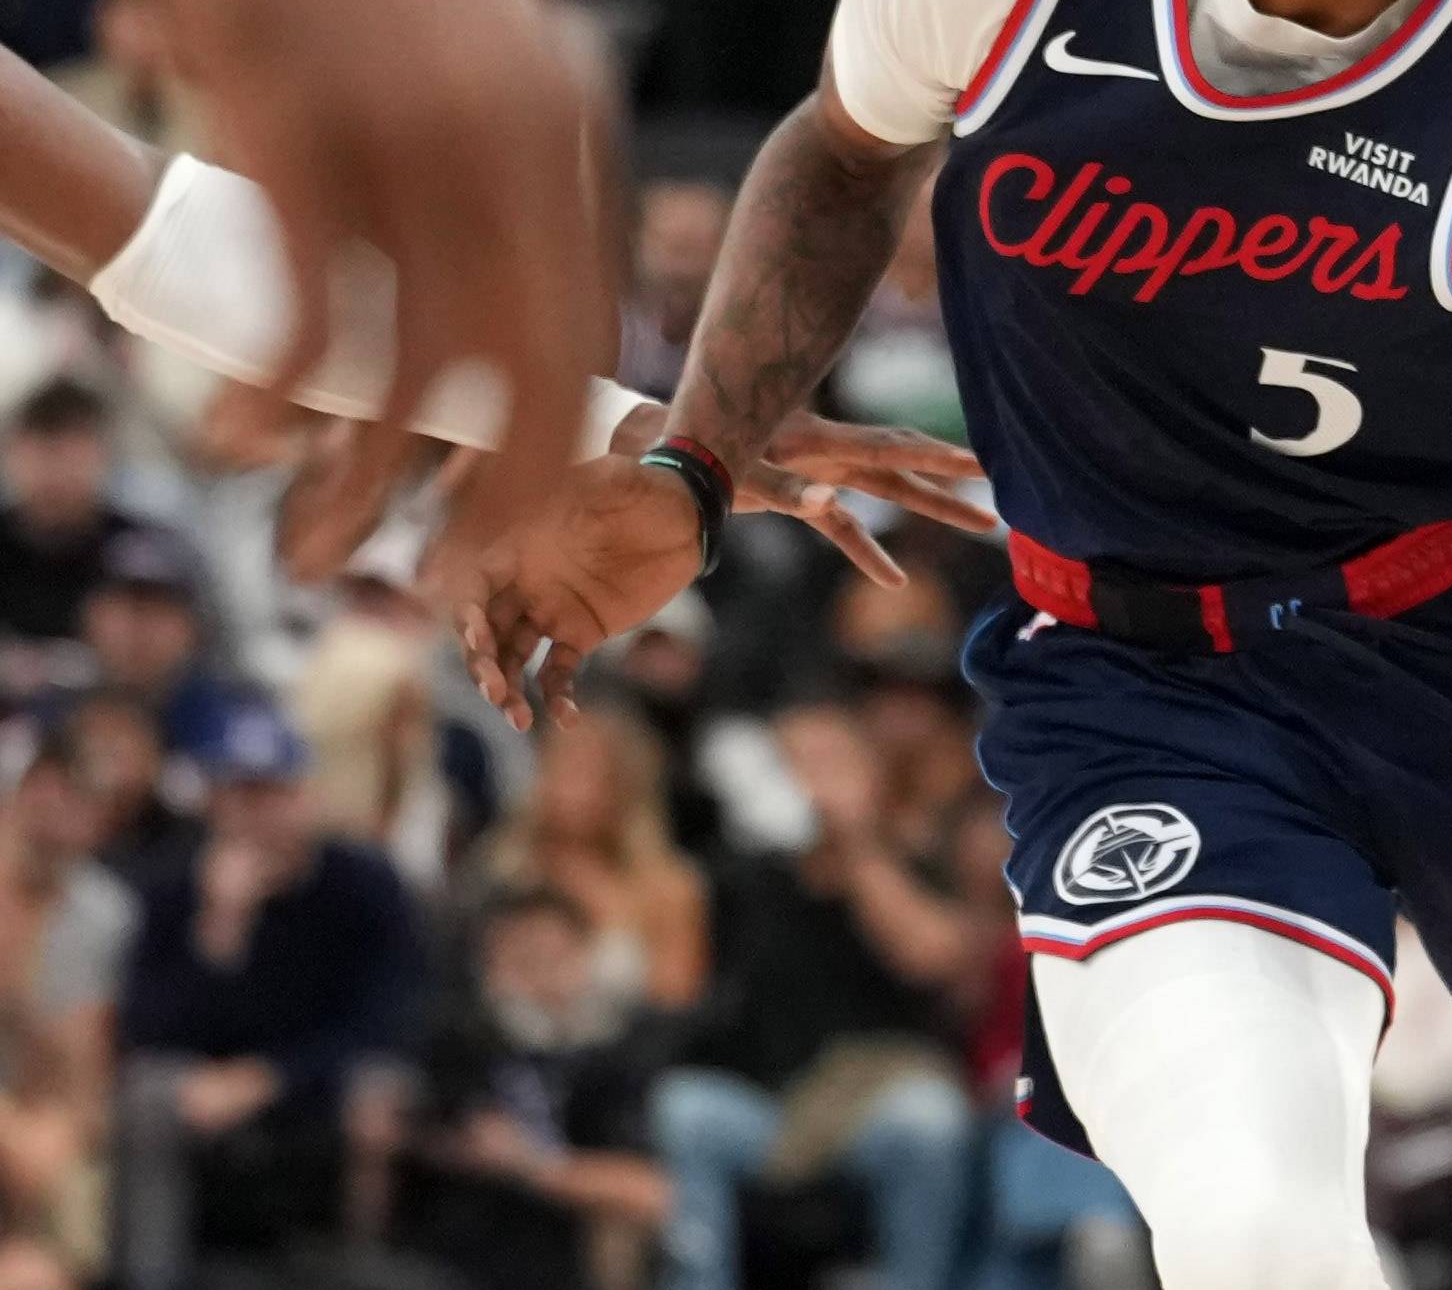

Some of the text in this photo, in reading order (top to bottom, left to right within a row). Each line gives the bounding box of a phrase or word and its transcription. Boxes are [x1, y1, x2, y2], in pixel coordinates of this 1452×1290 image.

[1308, 146, 1429, 206] RWANDA
[1345, 131, 1415, 173] VISIT
[979, 153, 1408, 303] Clippers
[1250, 346, 1363, 458] 5
